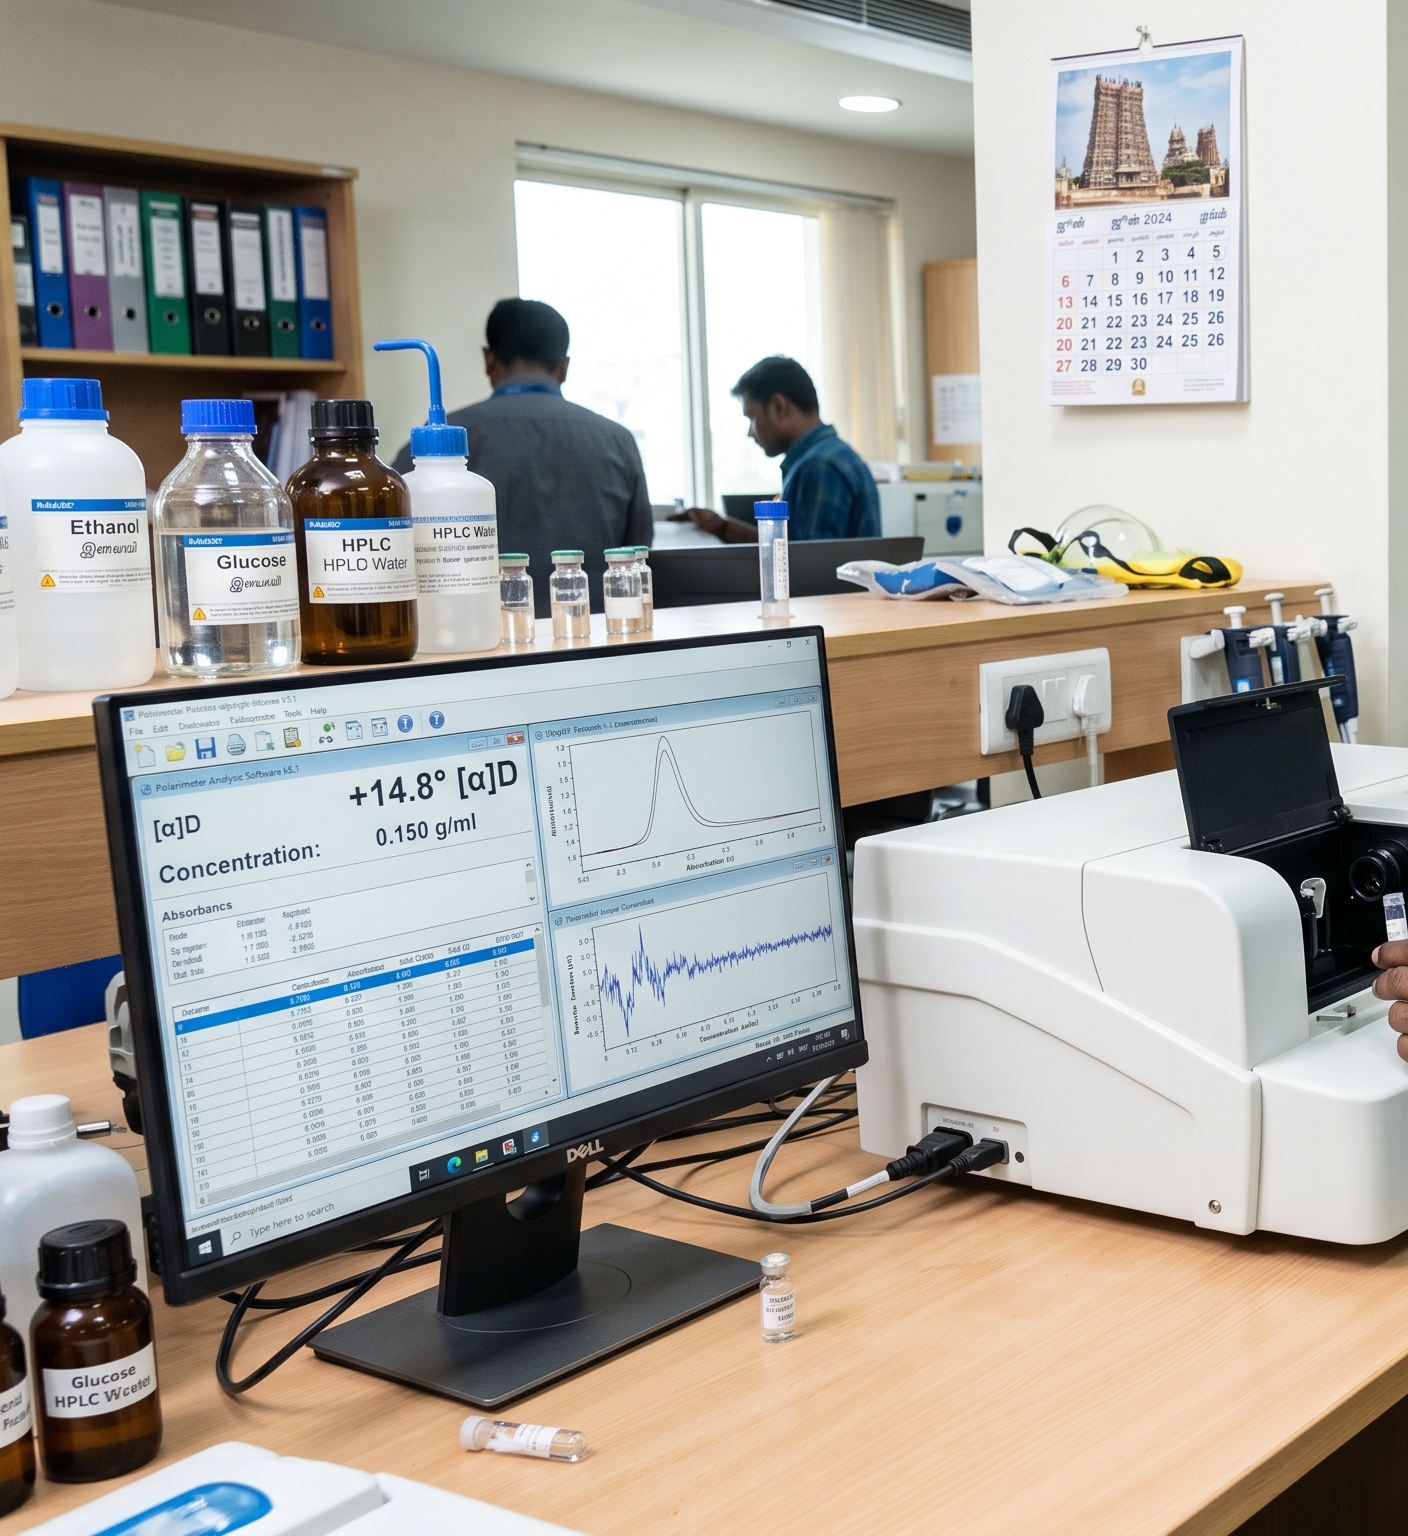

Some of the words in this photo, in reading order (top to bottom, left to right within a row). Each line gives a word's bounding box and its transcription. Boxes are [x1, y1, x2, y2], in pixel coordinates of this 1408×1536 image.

[1144, 212, 1172, 225] 2024
[1113, 252, 1118, 264] 1
[1136, 250, 1144, 263] 2
[1161, 248, 1169, 261] 3
[1187, 246, 1195, 259] 4
[1213, 245, 1220, 258] 5
[1061, 275, 1070, 288] 6
[1087, 275, 1094, 286] 7
[1111, 273, 1119, 286] 8
[1136, 272, 1144, 284] 9
[1158, 270, 1174, 283] 10
[1184, 269, 1198, 281] 11
[1209, 267, 1225, 280] 12
[1058, 296, 1073, 309] 13
[1082, 295, 1098, 307] 14
[1107, 294, 1123, 307] 15
[1132, 293, 1148, 305] 16
[1158, 292, 1173, 304] 17
[1183, 290, 1199, 303] 18
[1209, 289, 1224, 302] 19
[1057, 317, 1073, 330] 20
[1081, 317, 1096, 329] 21
[1106, 316, 1122, 328] 22
[1131, 314, 1148, 327] 23
[1156, 313, 1173, 326] 24
[1182, 312, 1198, 325] 25
[1208, 311, 1224, 324] 26
[1056, 339, 1072, 351] 20
[1081, 338, 1096, 350] 21
[1106, 337, 1122, 350] 22
[1131, 336, 1147, 349] 23
[1156, 335, 1173, 348] 24
[1182, 334, 1198, 347] 25
[1208, 333, 1224, 346] 26
[1056, 360, 1072, 372] 27
[1081, 359, 1097, 371] 28
[1106, 358, 1122, 371] 29
[1131, 358, 1147, 370] 30
[71, 519, 139, 534] Ethanol
[433, 527, 470, 539] HPLC
[474, 526, 496, 538] Wate
[342, 537, 391, 552] HPLC
[217, 555, 286, 569] Glucose
[372, 557, 407, 571] Water
[310, 707, 327, 716] Help
[349, 769, 446, 808] +14.8°
[457, 760, 518, 800] [α]D
[153, 814, 201, 843] [α]D
[376, 820, 429, 846] 0.150
[435, 812, 477, 841] g/ml
[159, 844, 321, 884] Concentration:
[566, 1139, 604, 1163] DELL
[249, 1225, 271, 1238] Type
[273, 1217, 292, 1229] here
[295, 1214, 304, 1222] to
[72, 1366, 136, 1388] Glucose
[55, 1393, 99, 1408] HPLC
